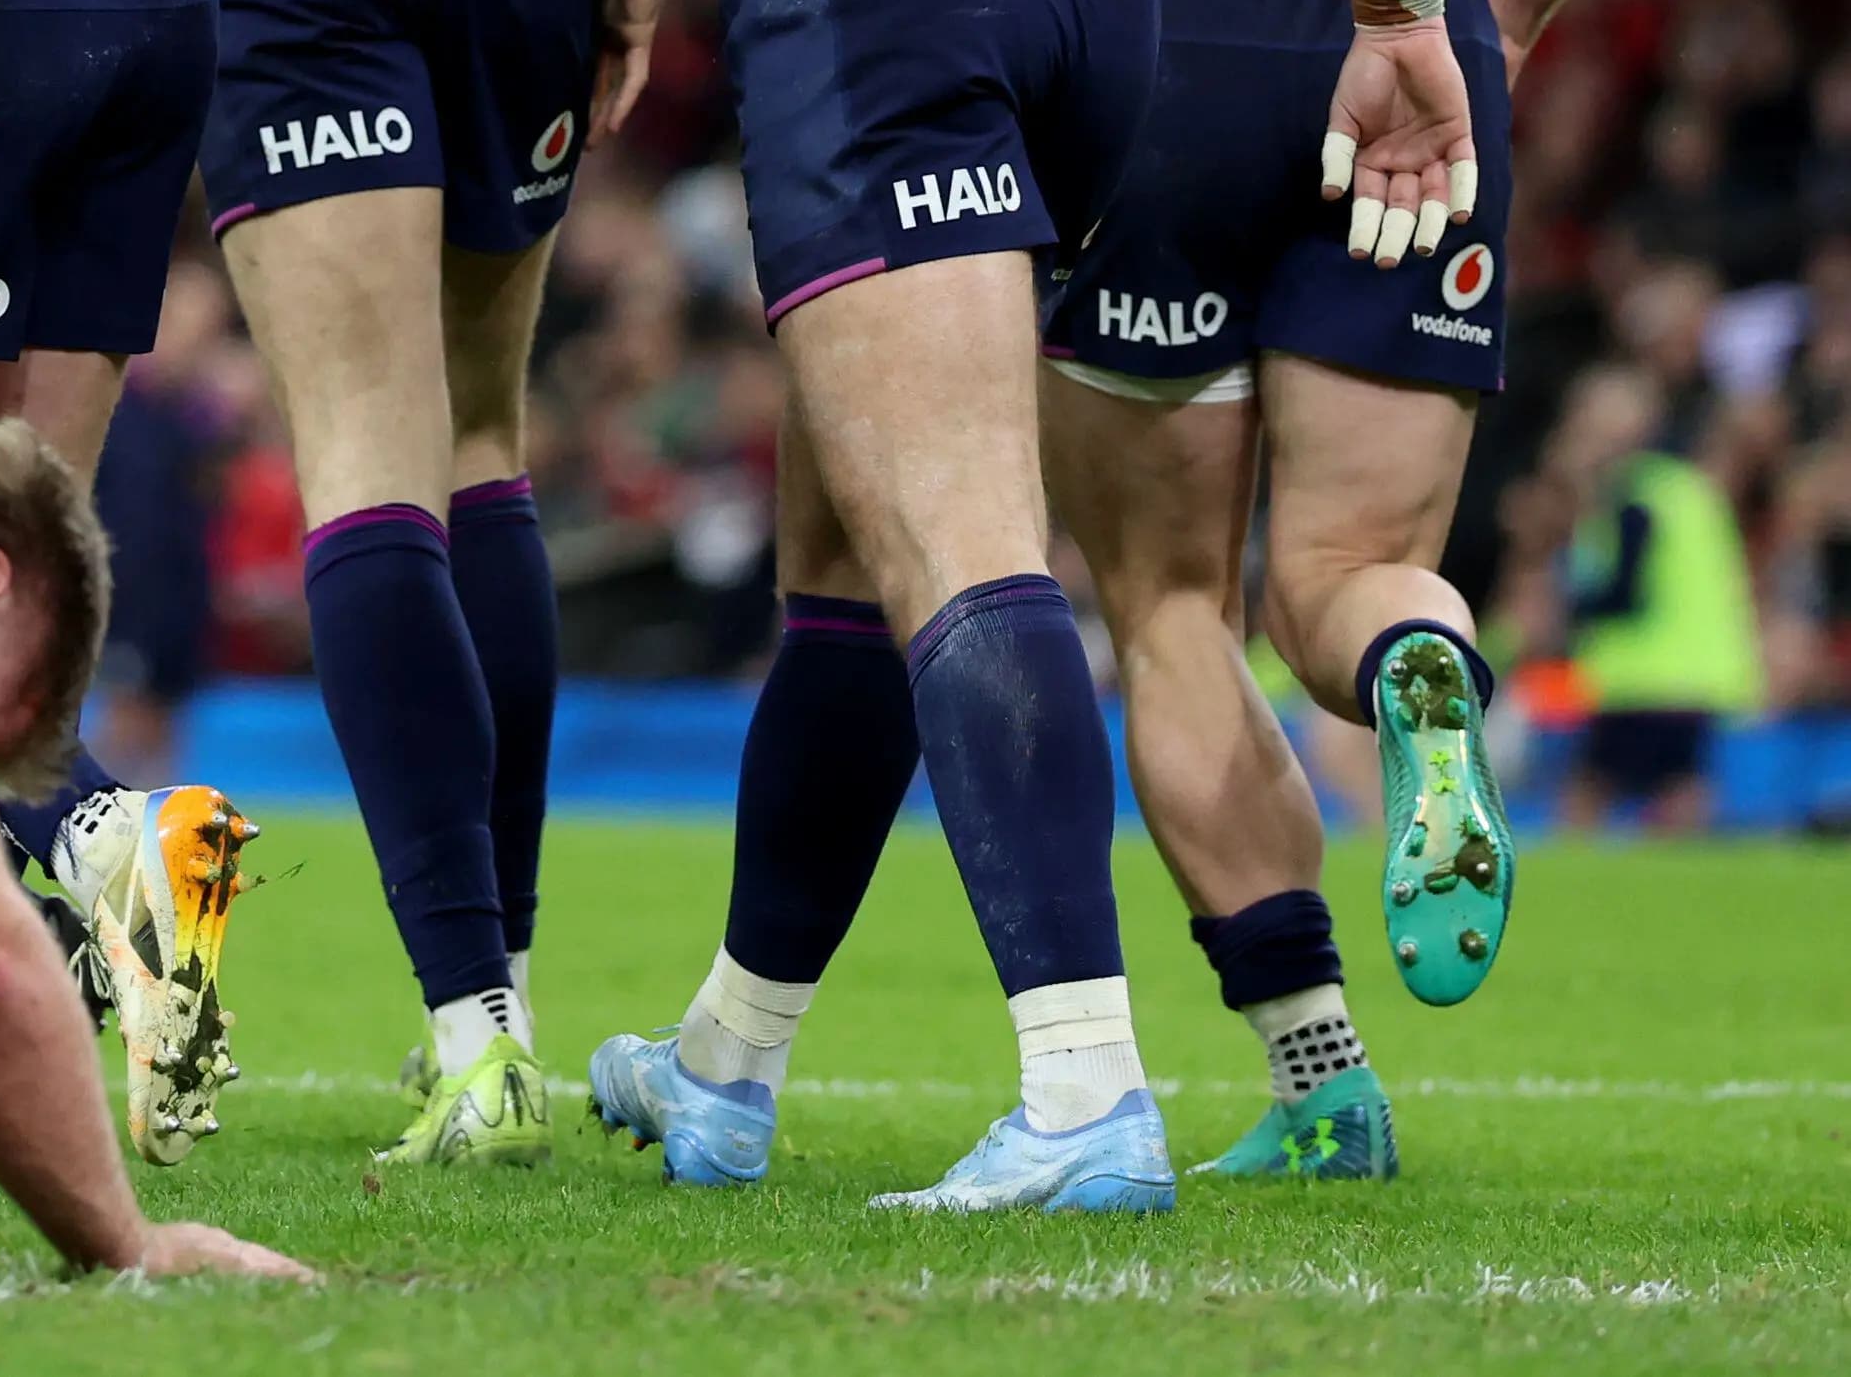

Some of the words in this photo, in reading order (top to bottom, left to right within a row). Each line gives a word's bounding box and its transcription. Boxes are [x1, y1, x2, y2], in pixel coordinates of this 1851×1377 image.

[259, 107, 413, 175] HALO
[893, 163, 1021, 230] HALO
[1098, 289, 1227, 346] HALO
[1411, 312, 1493, 346] vodafone
